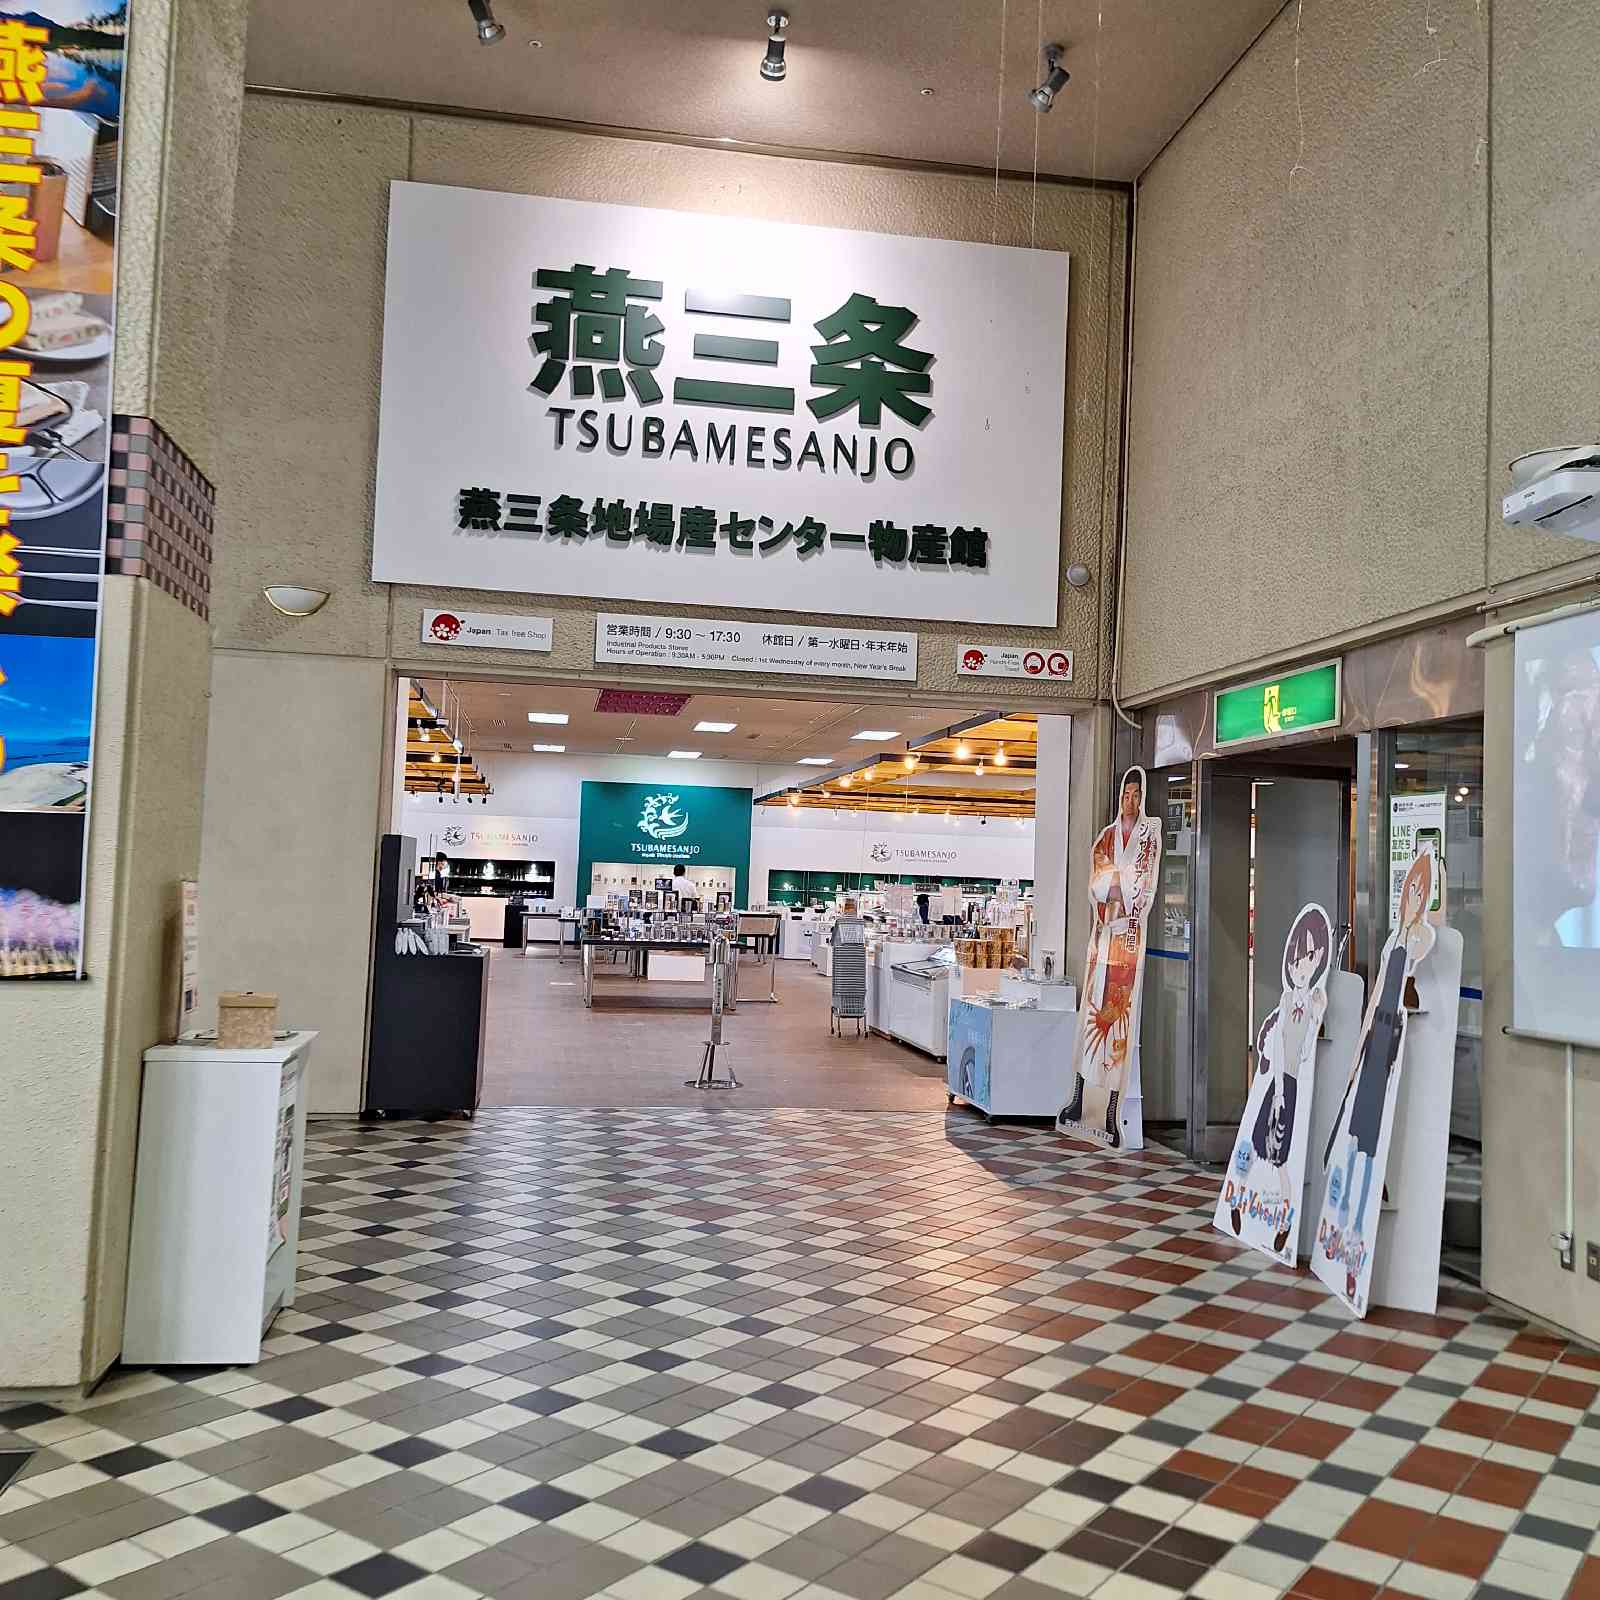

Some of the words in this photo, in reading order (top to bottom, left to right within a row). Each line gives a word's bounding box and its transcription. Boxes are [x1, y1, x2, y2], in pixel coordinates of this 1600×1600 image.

[529, 263, 935, 427] 燕三条
[548, 406, 915, 478] TSUBAMESANJO
[458, 486, 988, 568] 燕三条地場産センター物産館
[606, 623, 652, 639] 営業時間
[665, 627, 692, 640] 9:30
[709, 631, 741, 643] 17:30
[762, 632, 794, 647] 休館日
[606, 647, 626, 655] Hours
[769, 657, 805, 667] Wednesday
[1392, 825, 1411, 837] LINE
[630, 843, 700, 855] TSUBAMESANJO
[895, 848, 957, 860] TSUBAMESANJO
